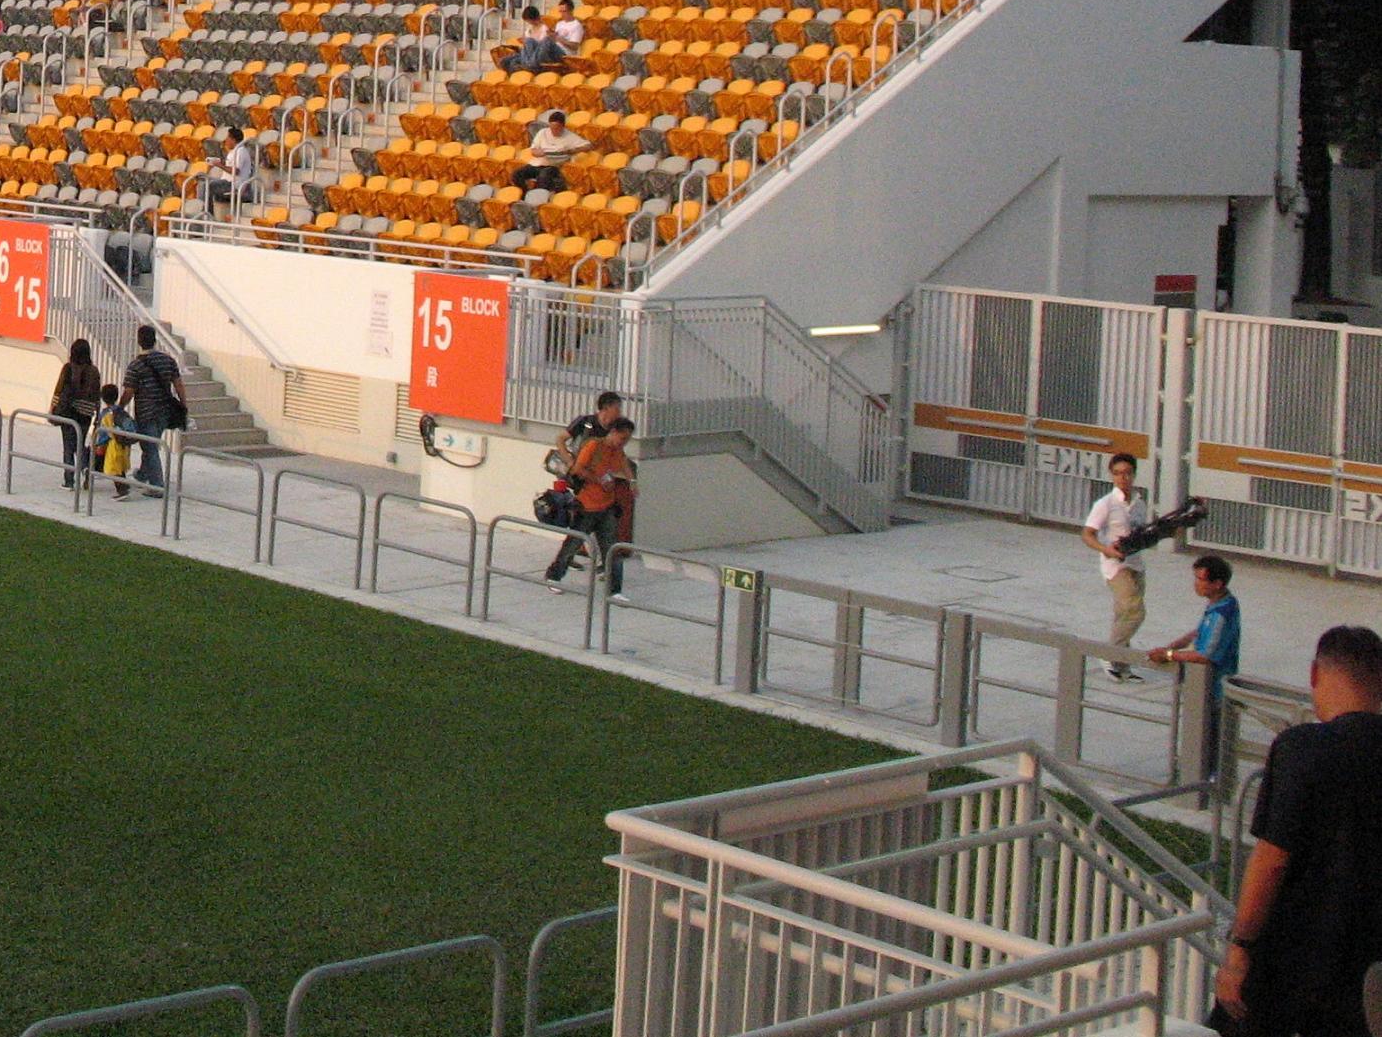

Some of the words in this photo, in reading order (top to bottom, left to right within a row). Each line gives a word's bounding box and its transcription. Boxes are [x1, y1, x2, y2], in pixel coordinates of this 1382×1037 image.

[15, 237, 43, 254] BLOCK
[14, 275, 41, 320] 15
[418, 297, 453, 351] 15
[461, 296, 500, 317] BLOCK
